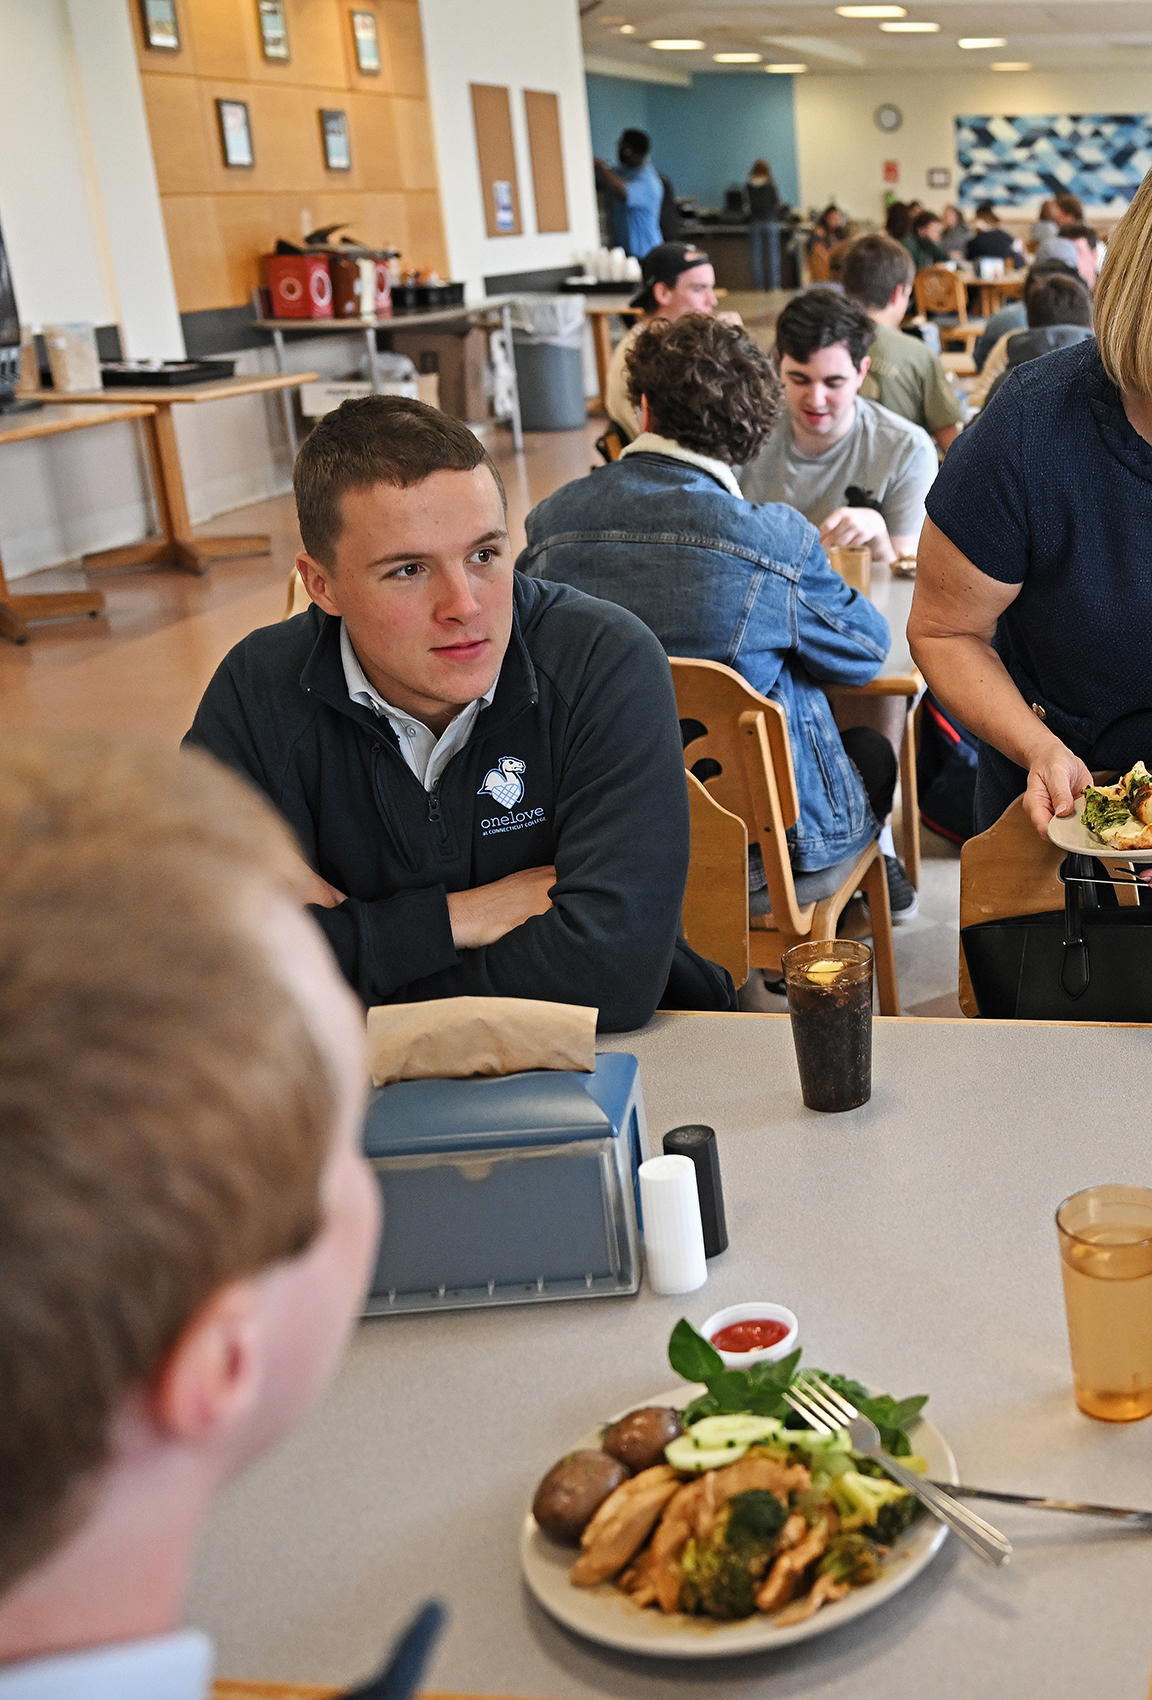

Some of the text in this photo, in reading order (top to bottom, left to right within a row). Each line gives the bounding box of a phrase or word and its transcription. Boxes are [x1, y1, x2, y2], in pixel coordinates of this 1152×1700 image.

[481, 807, 544, 829] onelove
[488, 824, 524, 835] CONNECTICUT
[524, 816, 547, 828] COLLEGE
